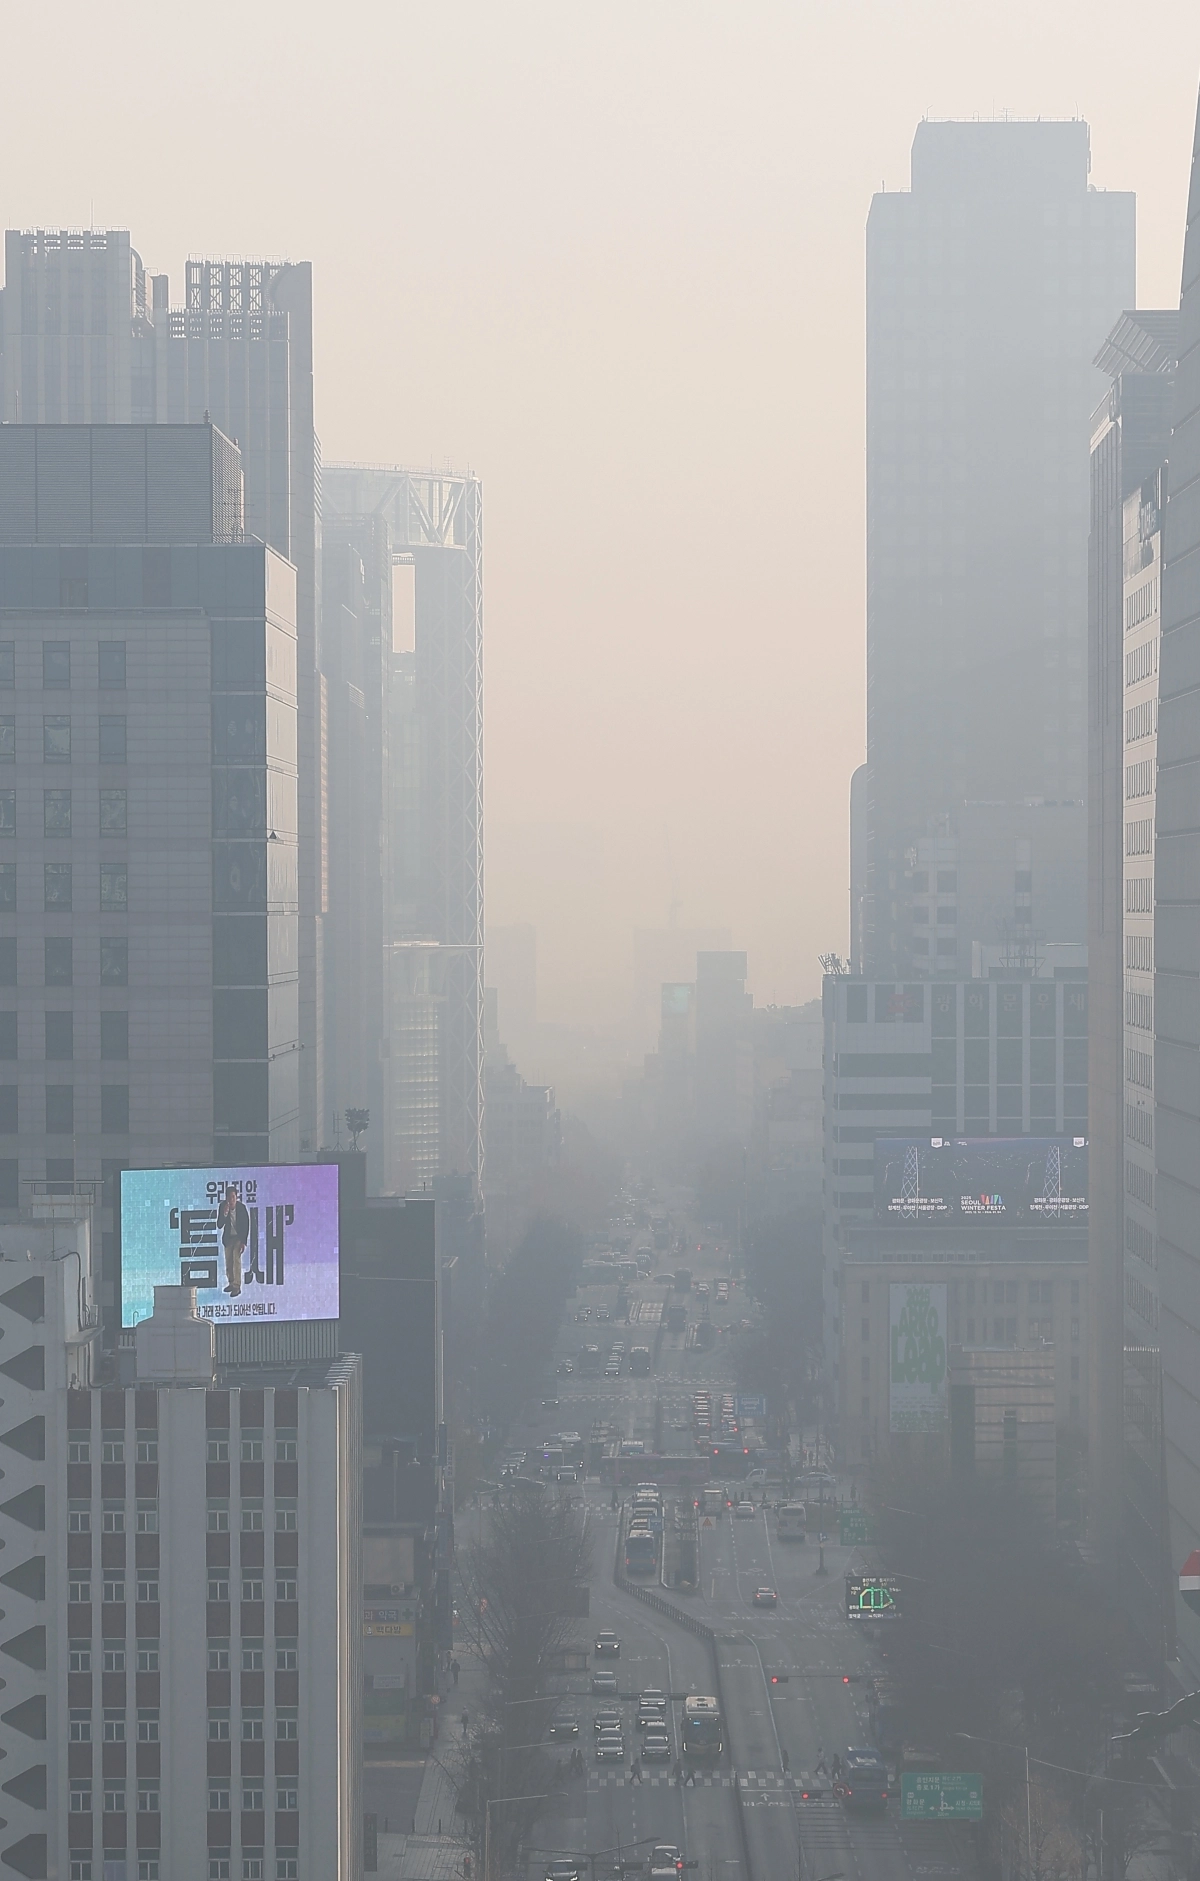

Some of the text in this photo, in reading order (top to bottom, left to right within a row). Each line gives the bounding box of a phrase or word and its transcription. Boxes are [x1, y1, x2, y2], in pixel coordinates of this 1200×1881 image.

[245, 1180, 257, 1203] 앞
[202, 1305, 214, 1318] 거래
[215, 1304, 232, 1317] 장소가
[234, 1304, 251, 1316] 되어선
[252, 1302, 277, 1315] 안됩니다.
[891, 1324, 946, 1395] Leap
[378, 1610, 397, 1620] 약국
